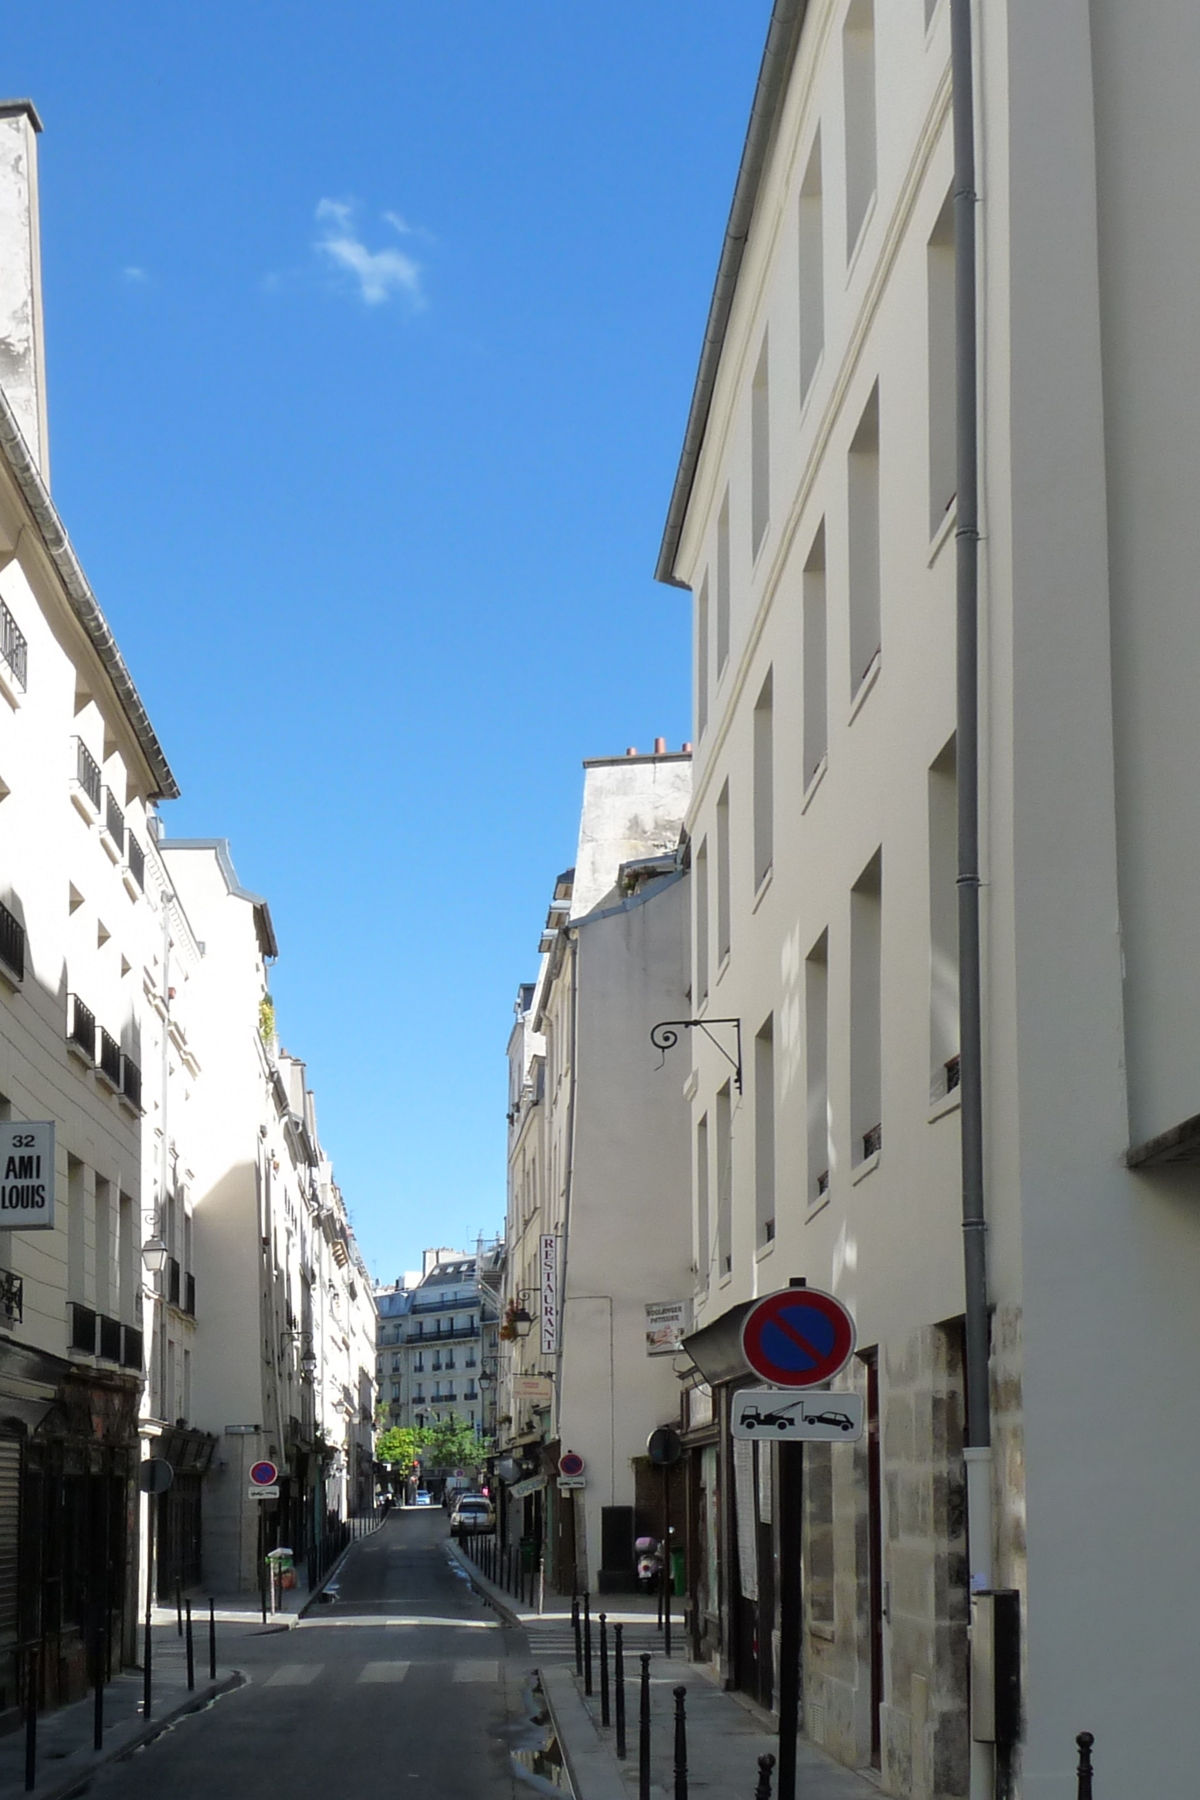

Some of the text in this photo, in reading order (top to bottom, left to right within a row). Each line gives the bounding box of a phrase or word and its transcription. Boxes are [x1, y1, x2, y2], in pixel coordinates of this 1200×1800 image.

[12, 1134, 36, 1148] 32
[5, 1155, 41, 1180] AMI
[1, 1184, 46, 1210] LOUIS
[543, 1238, 555, 1350] RESTAURANT
